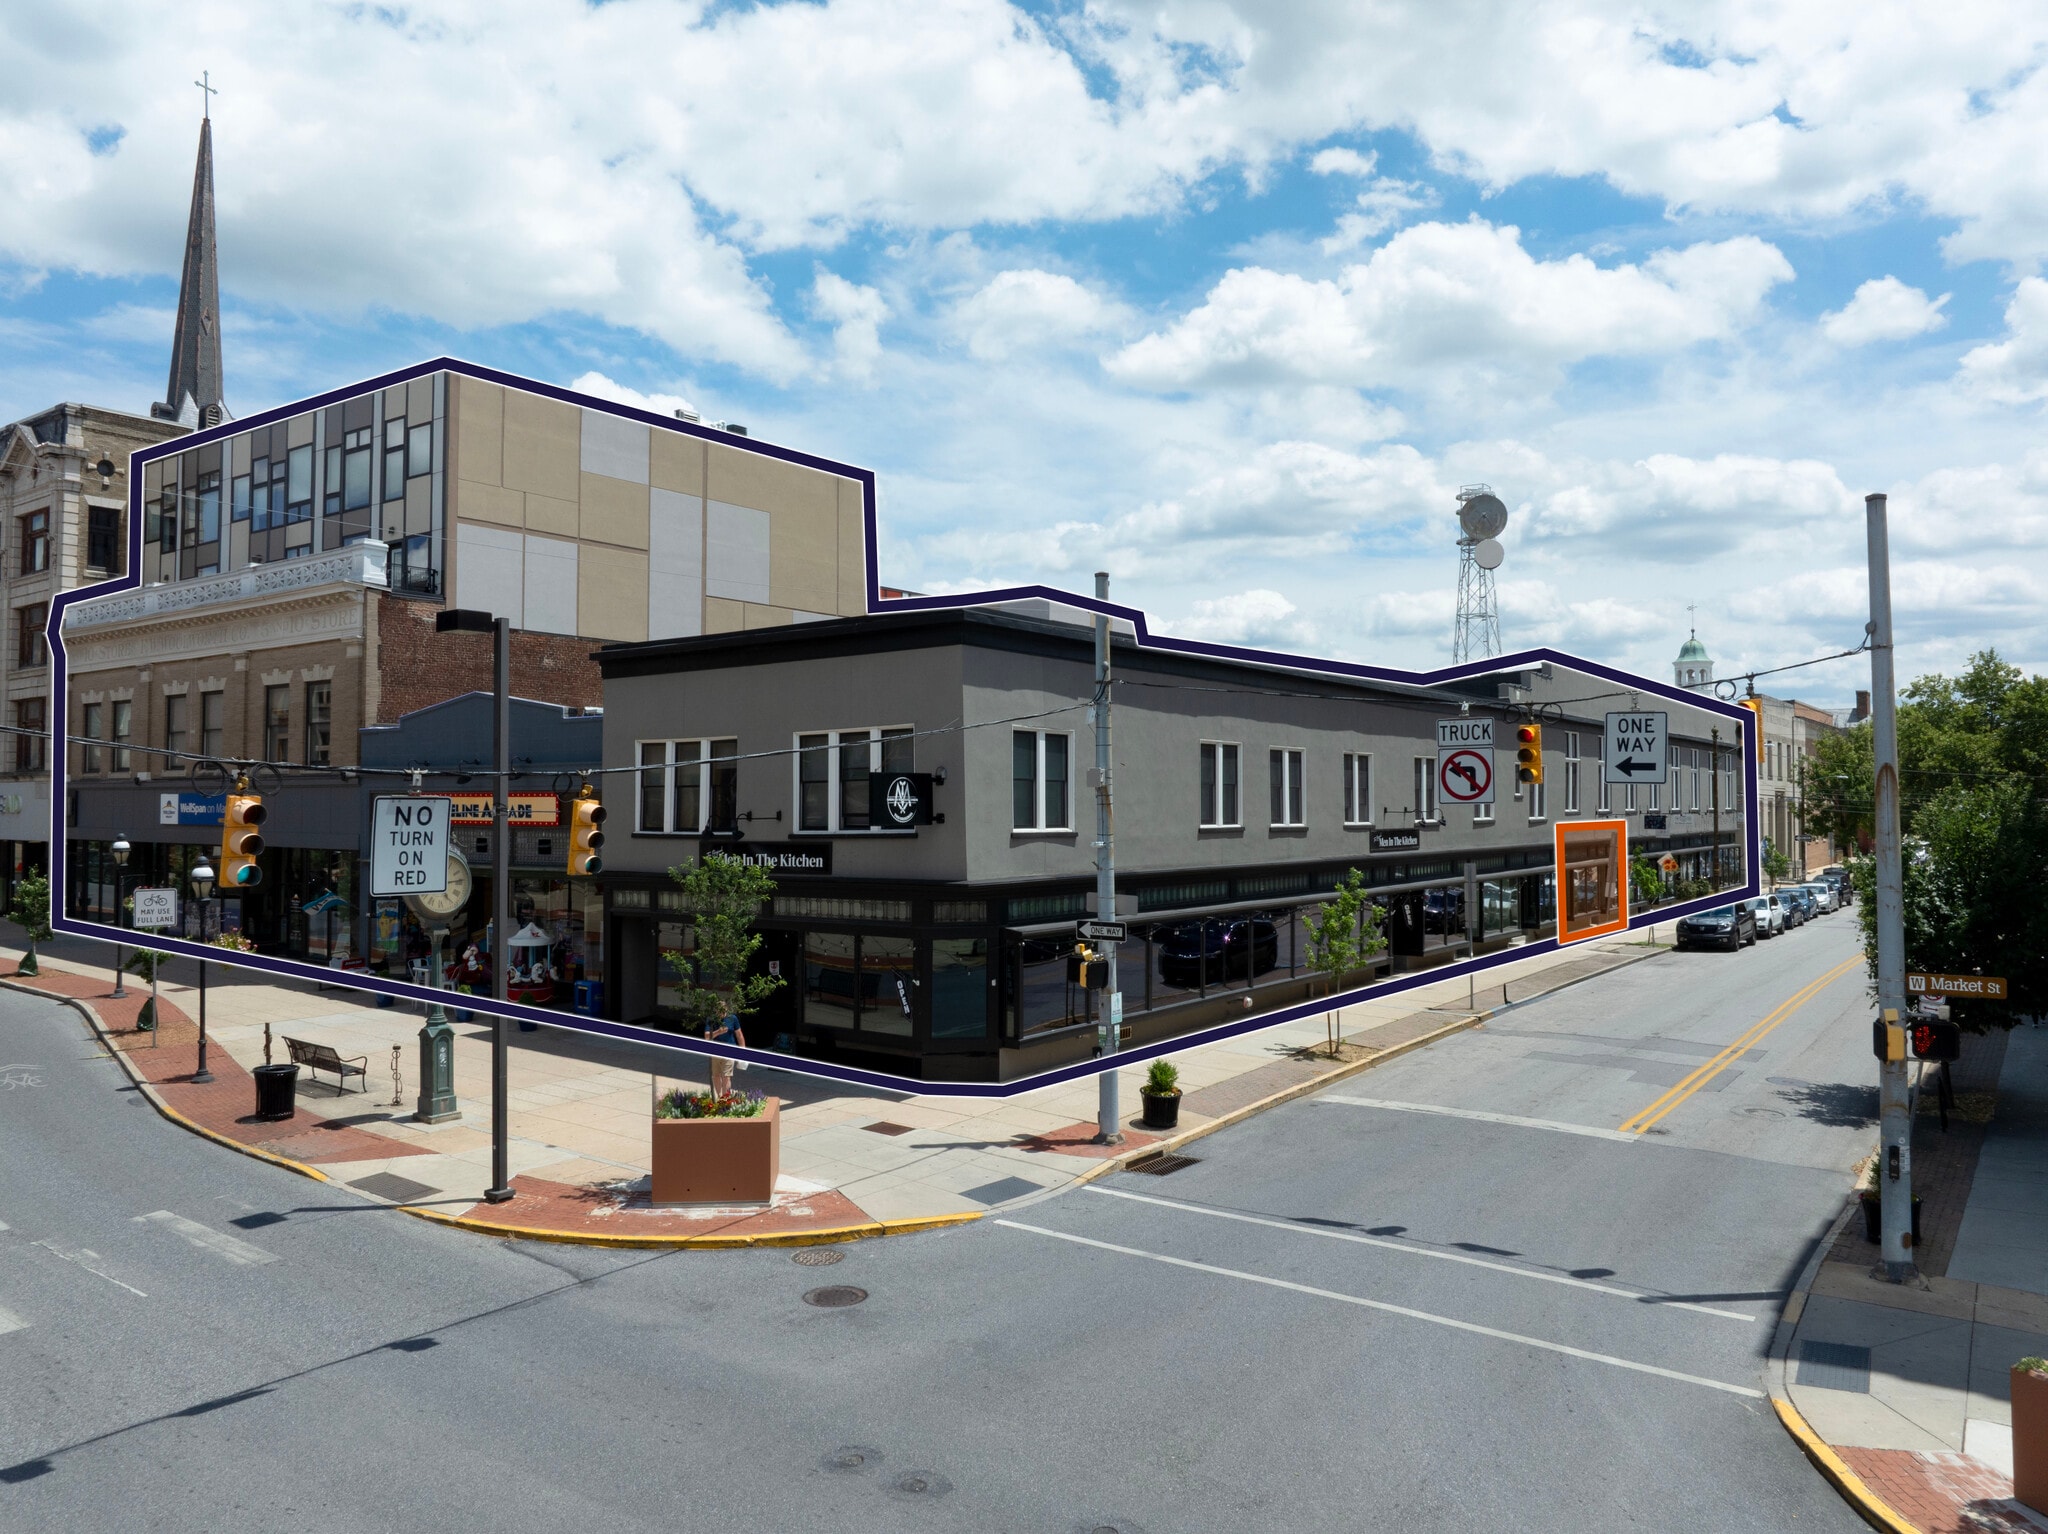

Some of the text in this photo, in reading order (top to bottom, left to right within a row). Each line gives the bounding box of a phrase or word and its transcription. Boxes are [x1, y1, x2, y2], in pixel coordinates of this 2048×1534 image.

[1439, 724, 1492, 741] TRUCK
[1618, 718, 1655, 733] ONE
[1616, 737, 1656, 752] WAY
[180, 803, 207, 816] WellSpan
[395, 805, 432, 826] NO
[480, 801, 532, 819] AADE
[390, 831, 433, 846] TURN
[399, 850, 423, 866] ON
[742, 853, 753, 867] In
[756, 853, 778, 868] The
[780, 853, 824, 868] Kitchen
[395, 870, 427, 886] RED
[157, 907, 170, 915] USE
[137, 915, 174, 924] FULL LANE
[1091, 926, 1121, 936] ONE WAY
[1910, 976, 2001, 994] W Market St
[896, 980, 911, 1014] OPEN
